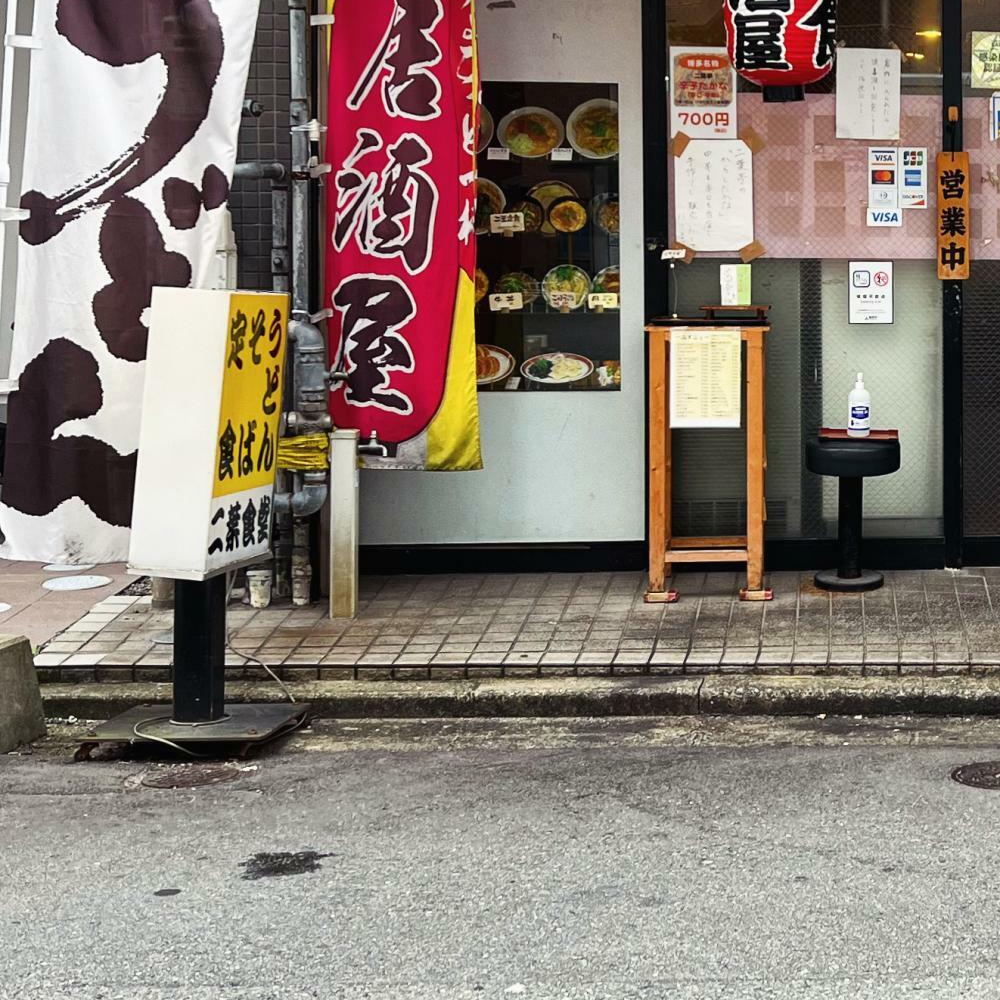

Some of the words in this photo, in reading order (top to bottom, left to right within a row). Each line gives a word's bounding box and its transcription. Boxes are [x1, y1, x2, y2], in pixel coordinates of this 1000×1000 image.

[678, 112, 729, 126] 700円
[903, 151, 923, 166] JCB
[872, 212, 899, 223] VISA
[940, 168, 966, 271] 営業中
[257, 308, 282, 472] うどん
